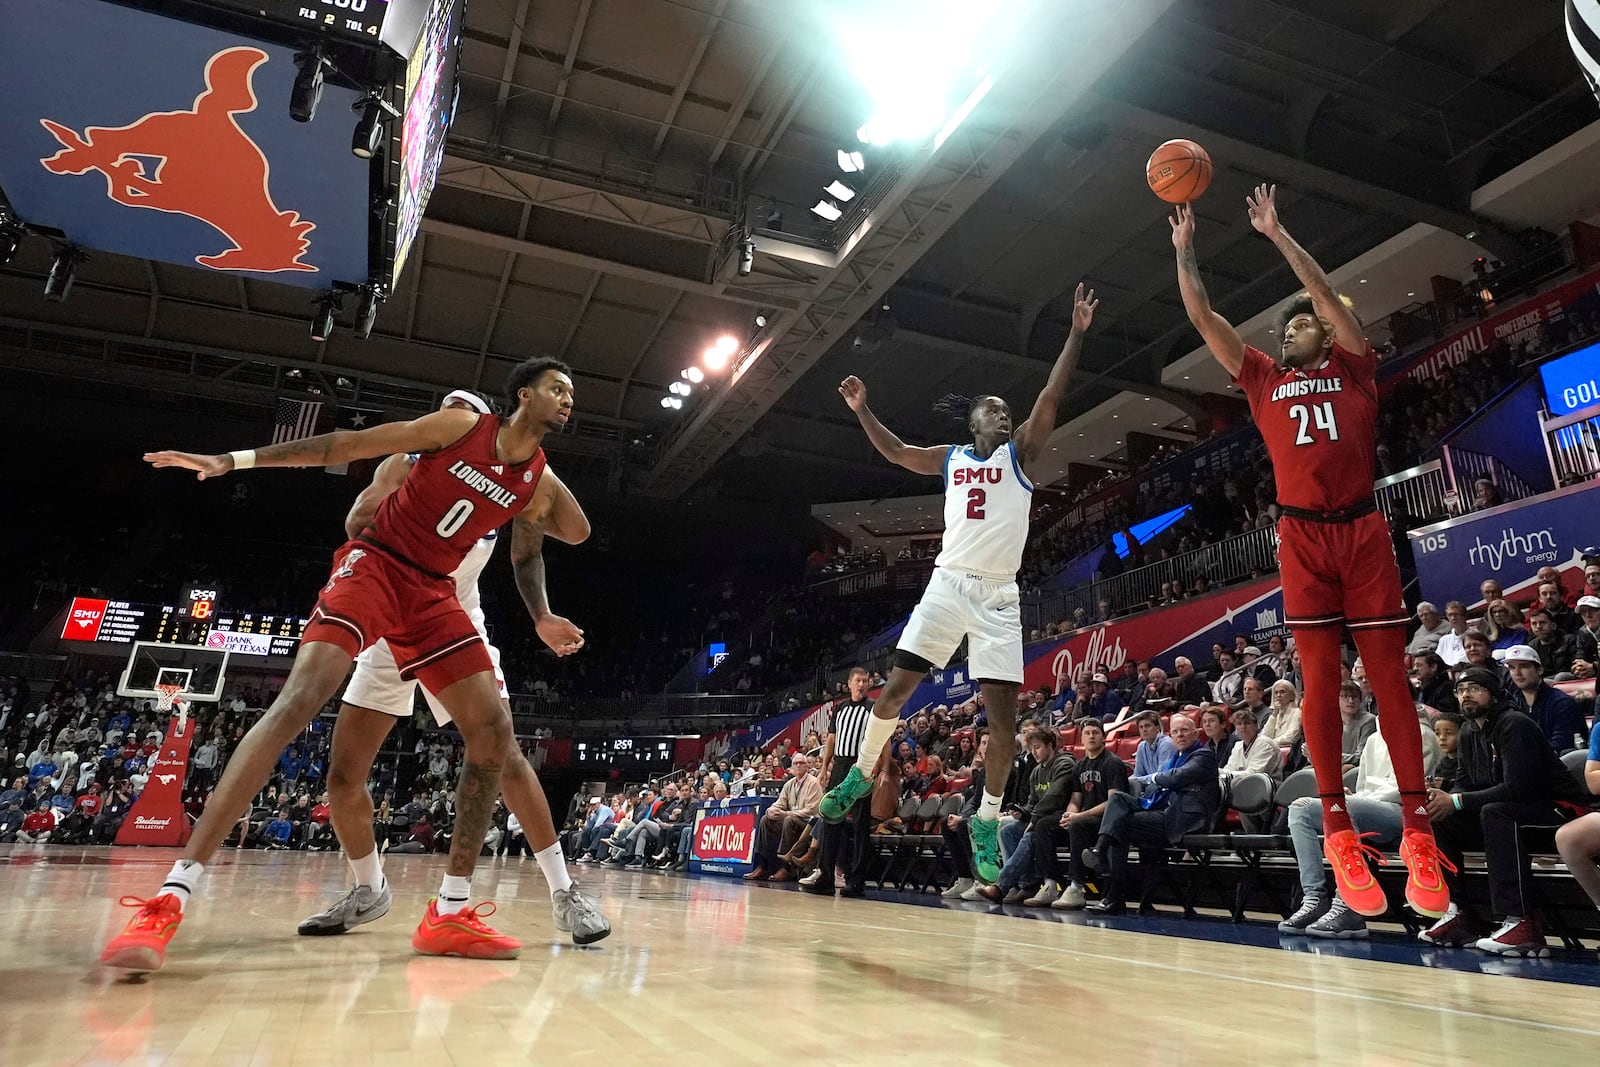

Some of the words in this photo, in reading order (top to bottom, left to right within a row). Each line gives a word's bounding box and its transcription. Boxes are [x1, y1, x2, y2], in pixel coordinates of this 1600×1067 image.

[299, 7, 317, 20] FLS
[324, 13, 336, 25] 2
[346, 19, 363, 32] TOL
[366, 25, 378, 36] 4
[1494, 309, 1542, 339] CONFERENCE
[1271, 377, 1342, 402] LOUISVILLE
[1289, 401, 1339, 445] 24
[447, 460, 518, 509] LOUISVILLE
[953, 468, 1002, 486] SMU
[966, 488, 986, 520] 2
[436, 498, 475, 538] 0
[1419, 533, 1447, 553] 105
[1468, 527, 1557, 571] rhythm
[1525, 550, 1558, 564] energy
[839, 577, 858, 596] HALL
[865, 570, 888, 589] FAME
[966, 573, 983, 581] SMU
[190, 590, 217, 601] 12:59
[74, 610, 101, 619] SMU
[109, 601, 130, 609] PLAYER
[162, 605, 174, 614] PTS
[191, 601, 210, 619] 18
[226, 635, 253, 645] BANK
[239, 644, 267, 653] TEXAS
[1051, 627, 1127, 696] Dallas
[614, 740, 632, 750] 12:59
[660, 750, 669, 760] 14
[700, 825, 727, 851] SMU
[726, 824, 746, 851] Cox
